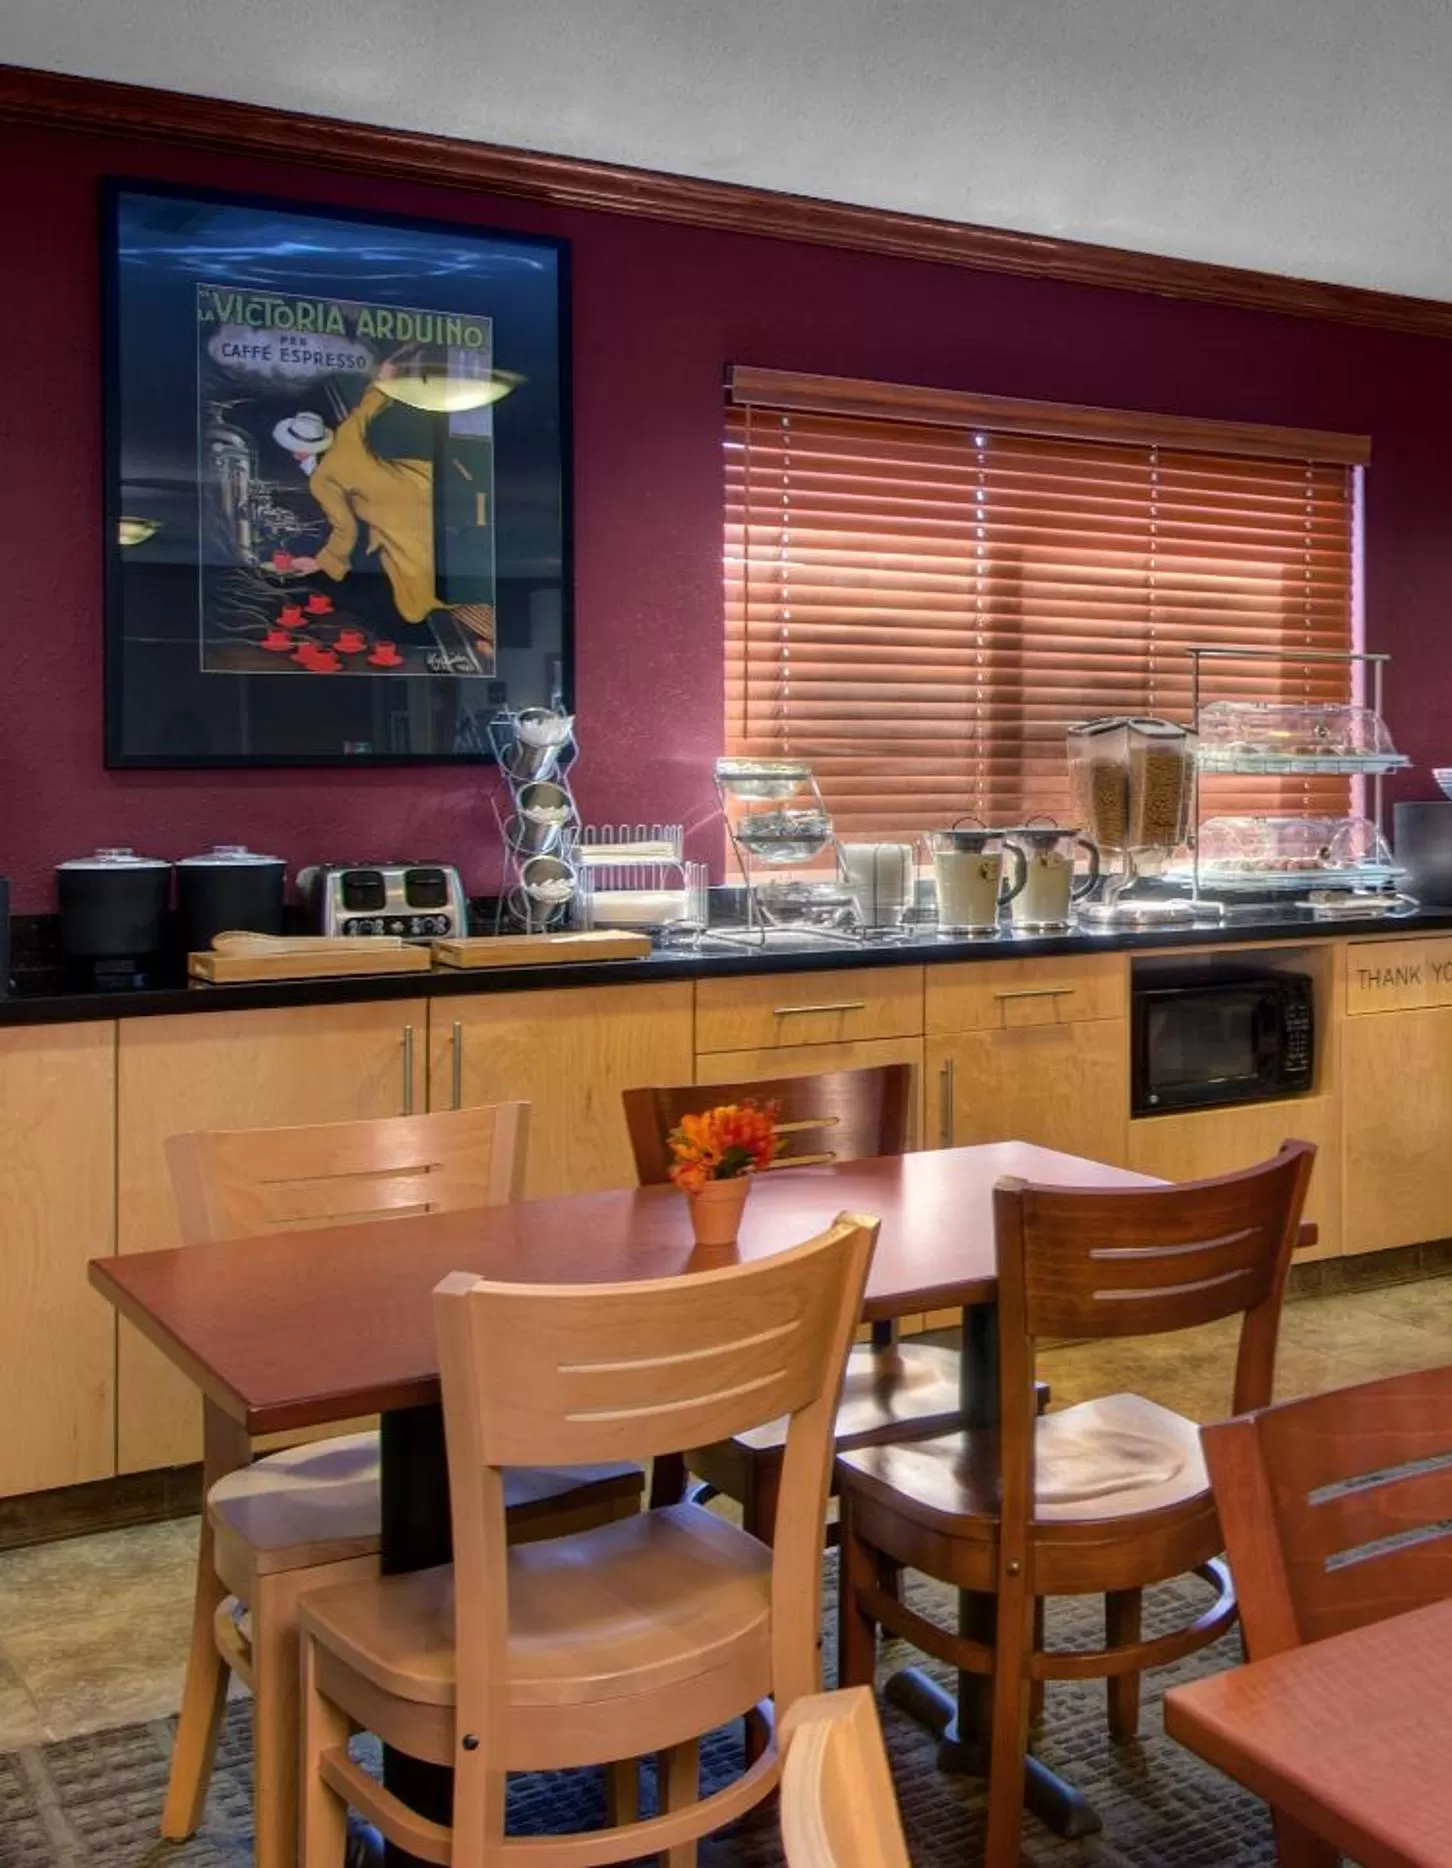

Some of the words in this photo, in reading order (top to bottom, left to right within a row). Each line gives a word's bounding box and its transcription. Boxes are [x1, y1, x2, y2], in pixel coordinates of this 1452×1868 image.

[213, 291, 346, 335] VICTORIA
[356, 307, 483, 348] ARDUINO
[279, 346, 367, 370] ESPRESSO
[1356, 965, 1422, 991] THANK
